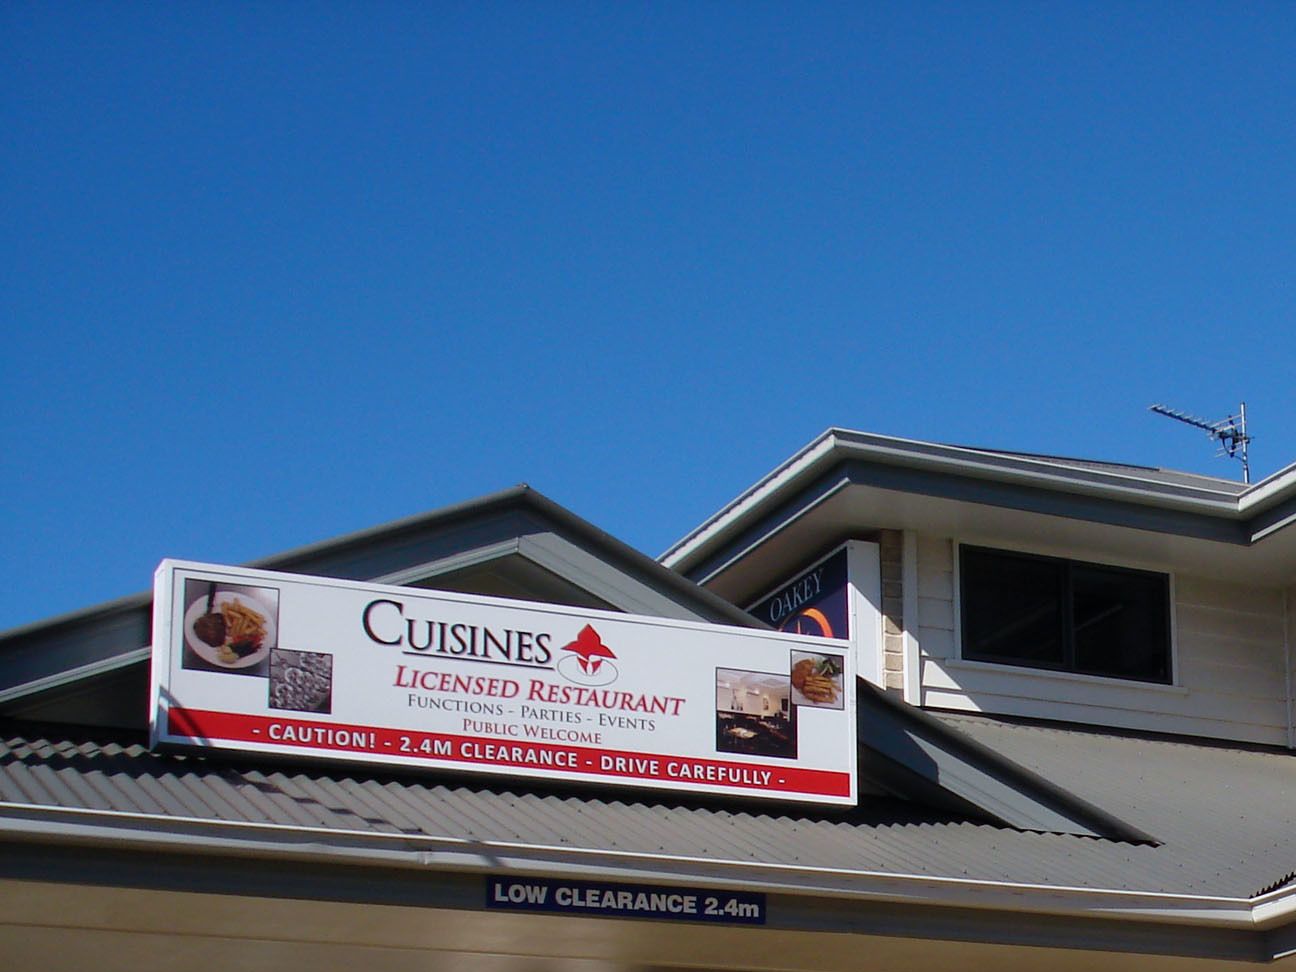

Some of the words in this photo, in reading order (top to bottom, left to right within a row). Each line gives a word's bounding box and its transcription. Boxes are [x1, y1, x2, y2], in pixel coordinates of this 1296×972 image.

[769, 567, 824, 623] OAKEY
[362, 598, 553, 664] CUISINES
[392, 664, 520, 699] LICENSED
[528, 679, 687, 716] RESTAURANT
[407, 693, 504, 716] FUNCTIONS
[521, 705, 582, 724] PARTIES
[599, 712, 656, 731] EVENTS
[268, 723, 377, 749] CAUTION!
[400, 736, 452, 756] 2.4M
[460, 742, 578, 768] CLEARANCE
[601, 756, 659, 775] DRIVE
[667, 762, 772, 785] CAREFULLY
[462, 718, 518, 737] PUBLIC
[523, 723, 602, 744] WELCOME
[494, 883, 548, 904] LOW
[555, 887, 697, 914] CLEARANCE
[704, 897, 760, 918] 2.4m
